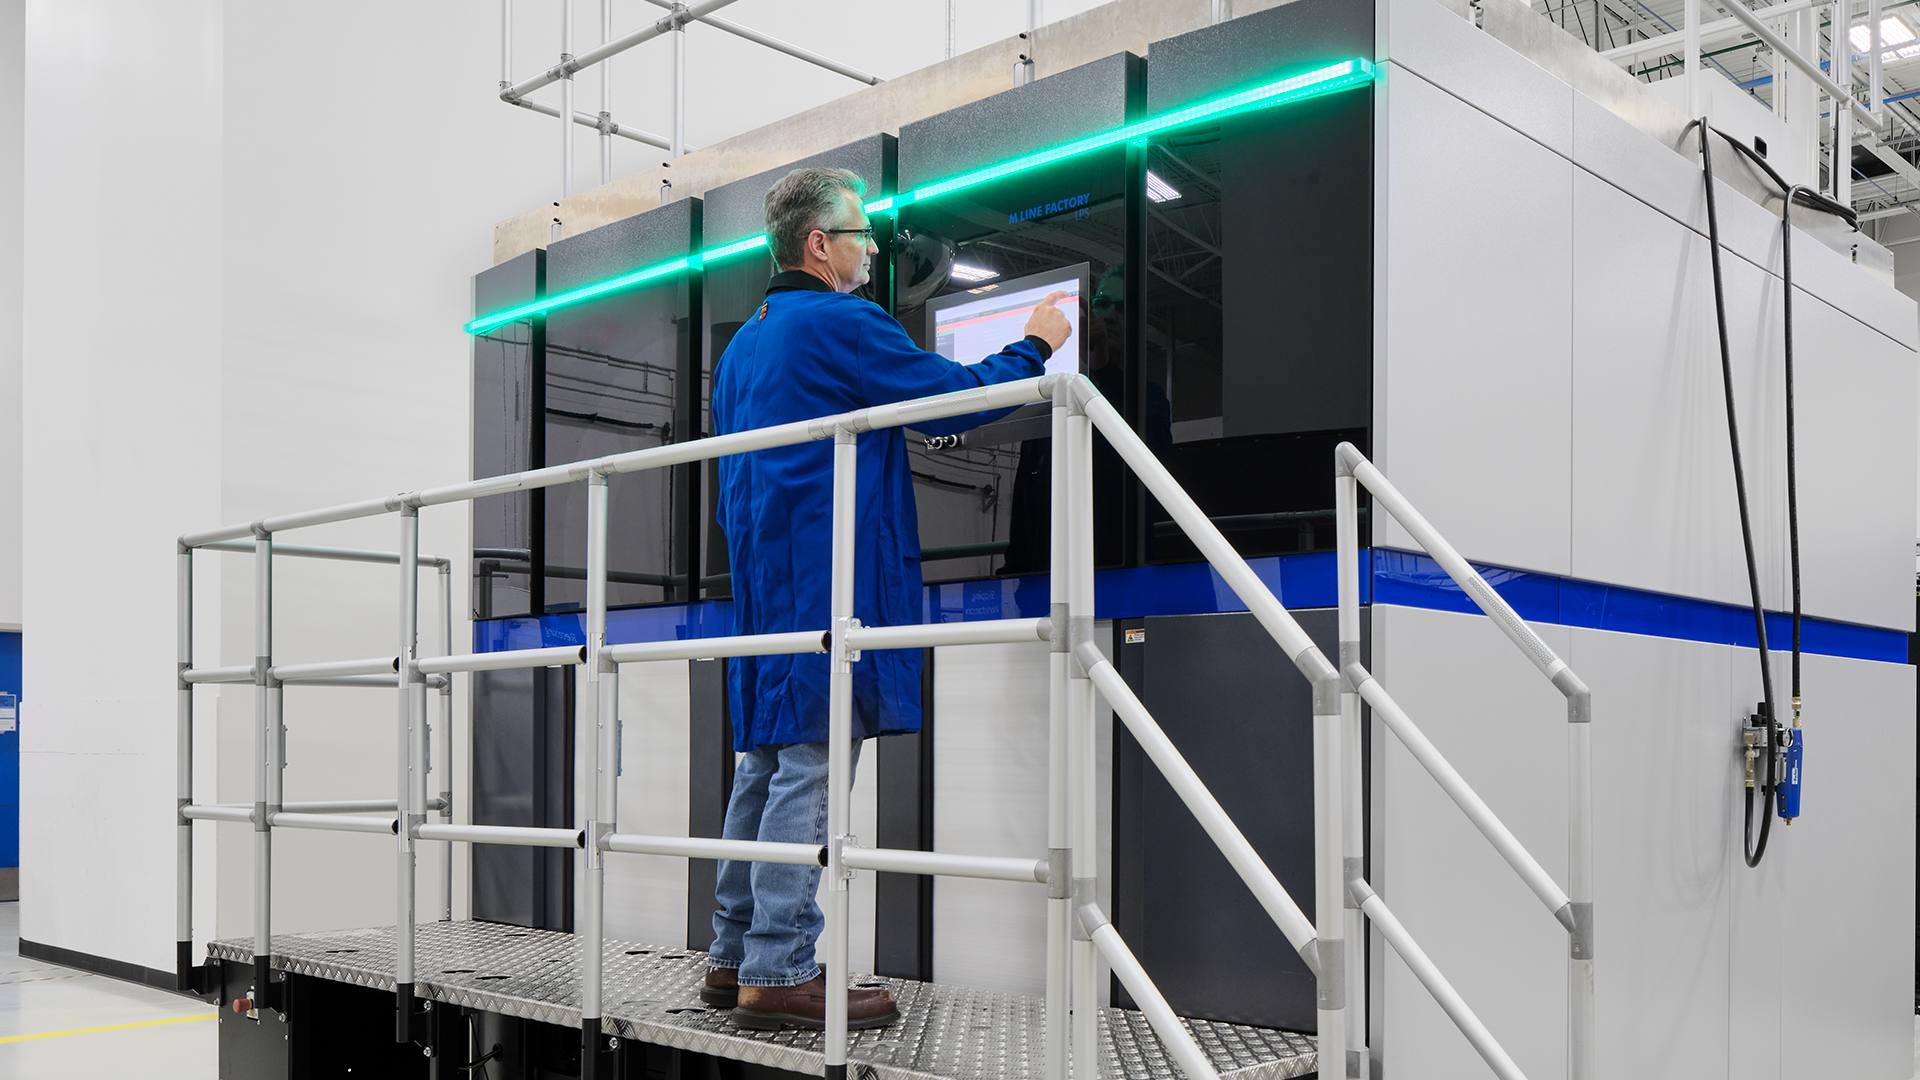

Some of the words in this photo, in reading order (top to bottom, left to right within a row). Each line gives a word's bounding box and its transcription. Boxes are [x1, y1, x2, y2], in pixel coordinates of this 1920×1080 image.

[1009, 212, 1018, 224] M
[1020, 205, 1042, 221] LINE
[1045, 192, 1090, 215] FACTORY
[1075, 207, 1090, 221] LPS
